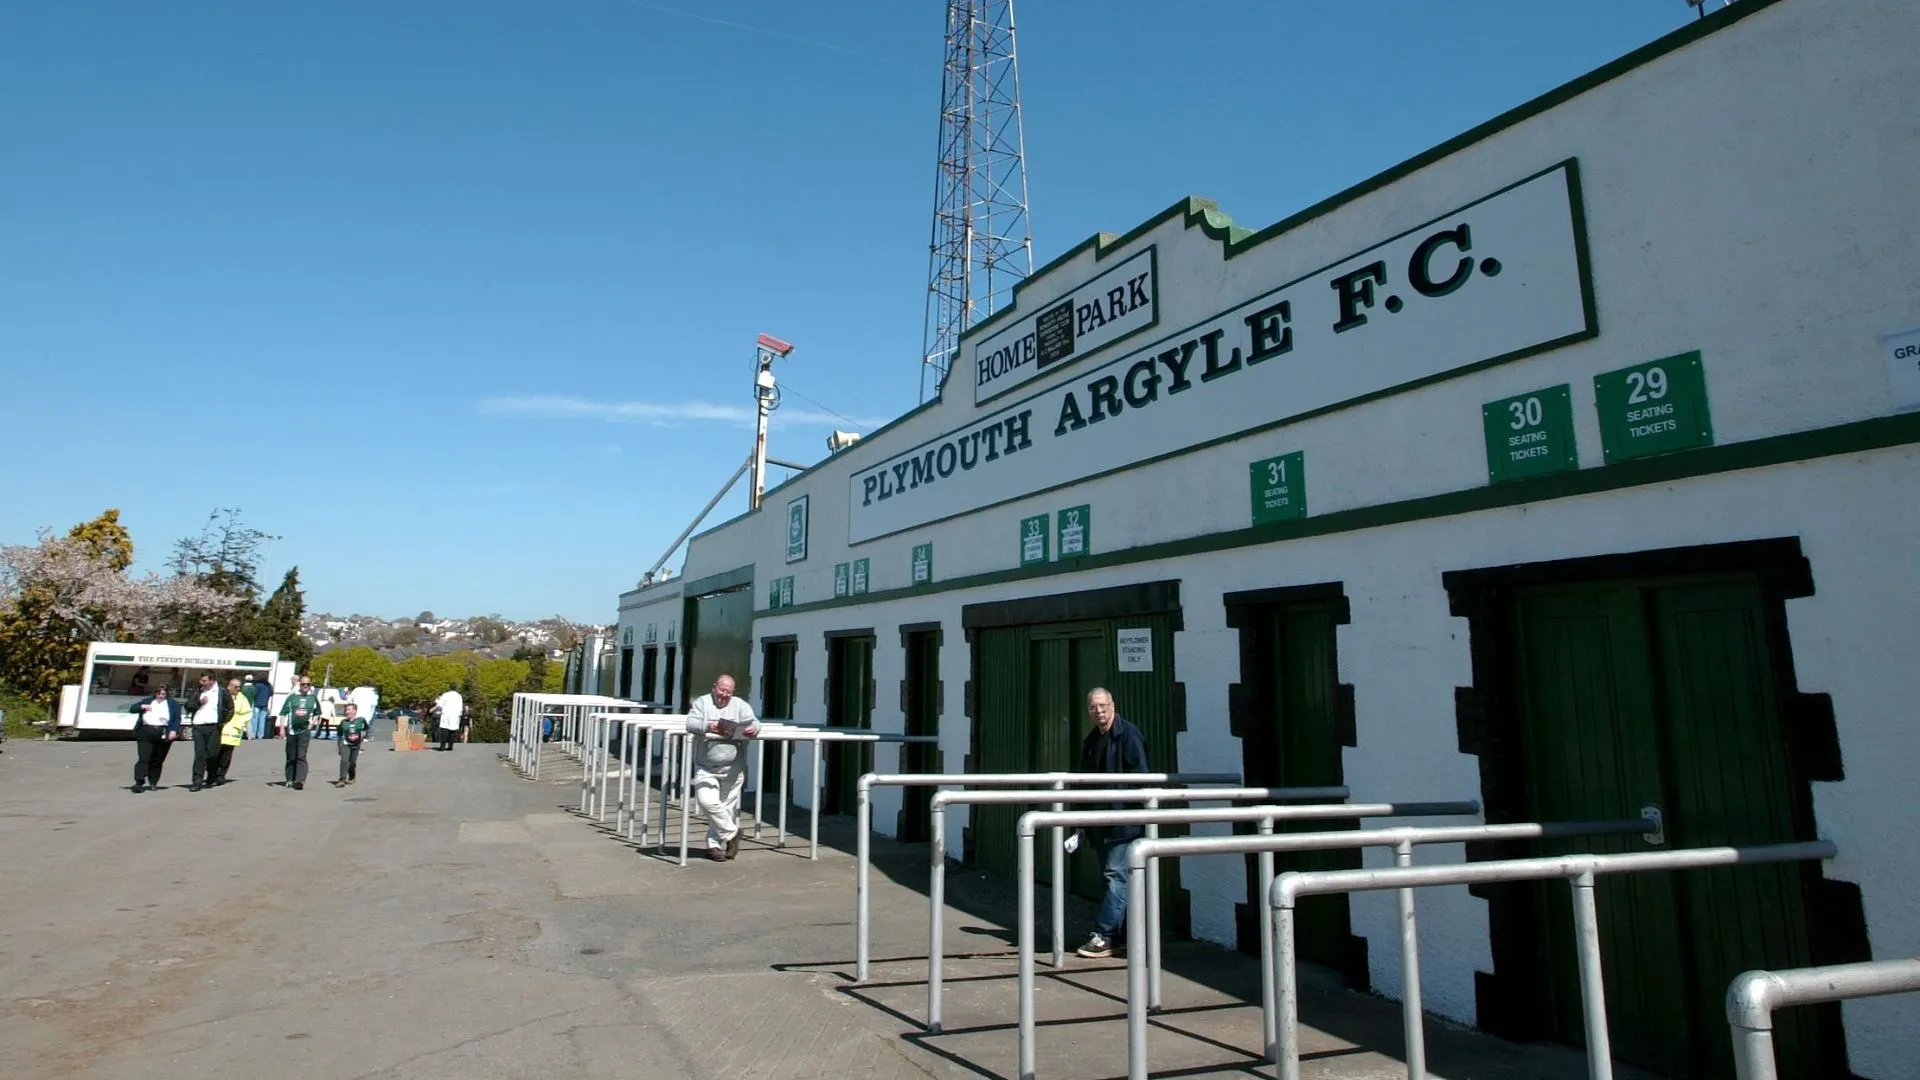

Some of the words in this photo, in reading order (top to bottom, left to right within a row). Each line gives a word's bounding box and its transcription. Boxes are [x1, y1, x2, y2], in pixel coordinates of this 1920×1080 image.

[977, 332, 1036, 387] HOME
[1075, 271, 1150, 338] PARK
[1894, 344, 1920, 360] GR
[862, 409, 1033, 507] PLYMOUTH
[1054, 300, 1294, 438] ARGYLE
[1331, 223, 1502, 335] F.C.
[1625, 366, 1668, 405] 29
[1508, 397, 1543, 431] 30
[1626, 403, 1674, 423] SEATING
[1508, 430, 1548, 447] SEATING
[1628, 419, 1677, 439] TICKETS
[1509, 445, 1549, 462] TICKETS
[1267, 459, 1286, 485] 31
[1264, 486, 1289, 498] SEATING
[1264, 497, 1289, 509] TICKETS
[1027, 519, 1040, 537] 33
[1066, 510, 1080, 529] 32
[156, 656, 183, 664] FINEST
[184, 657, 216, 665] BURGER
